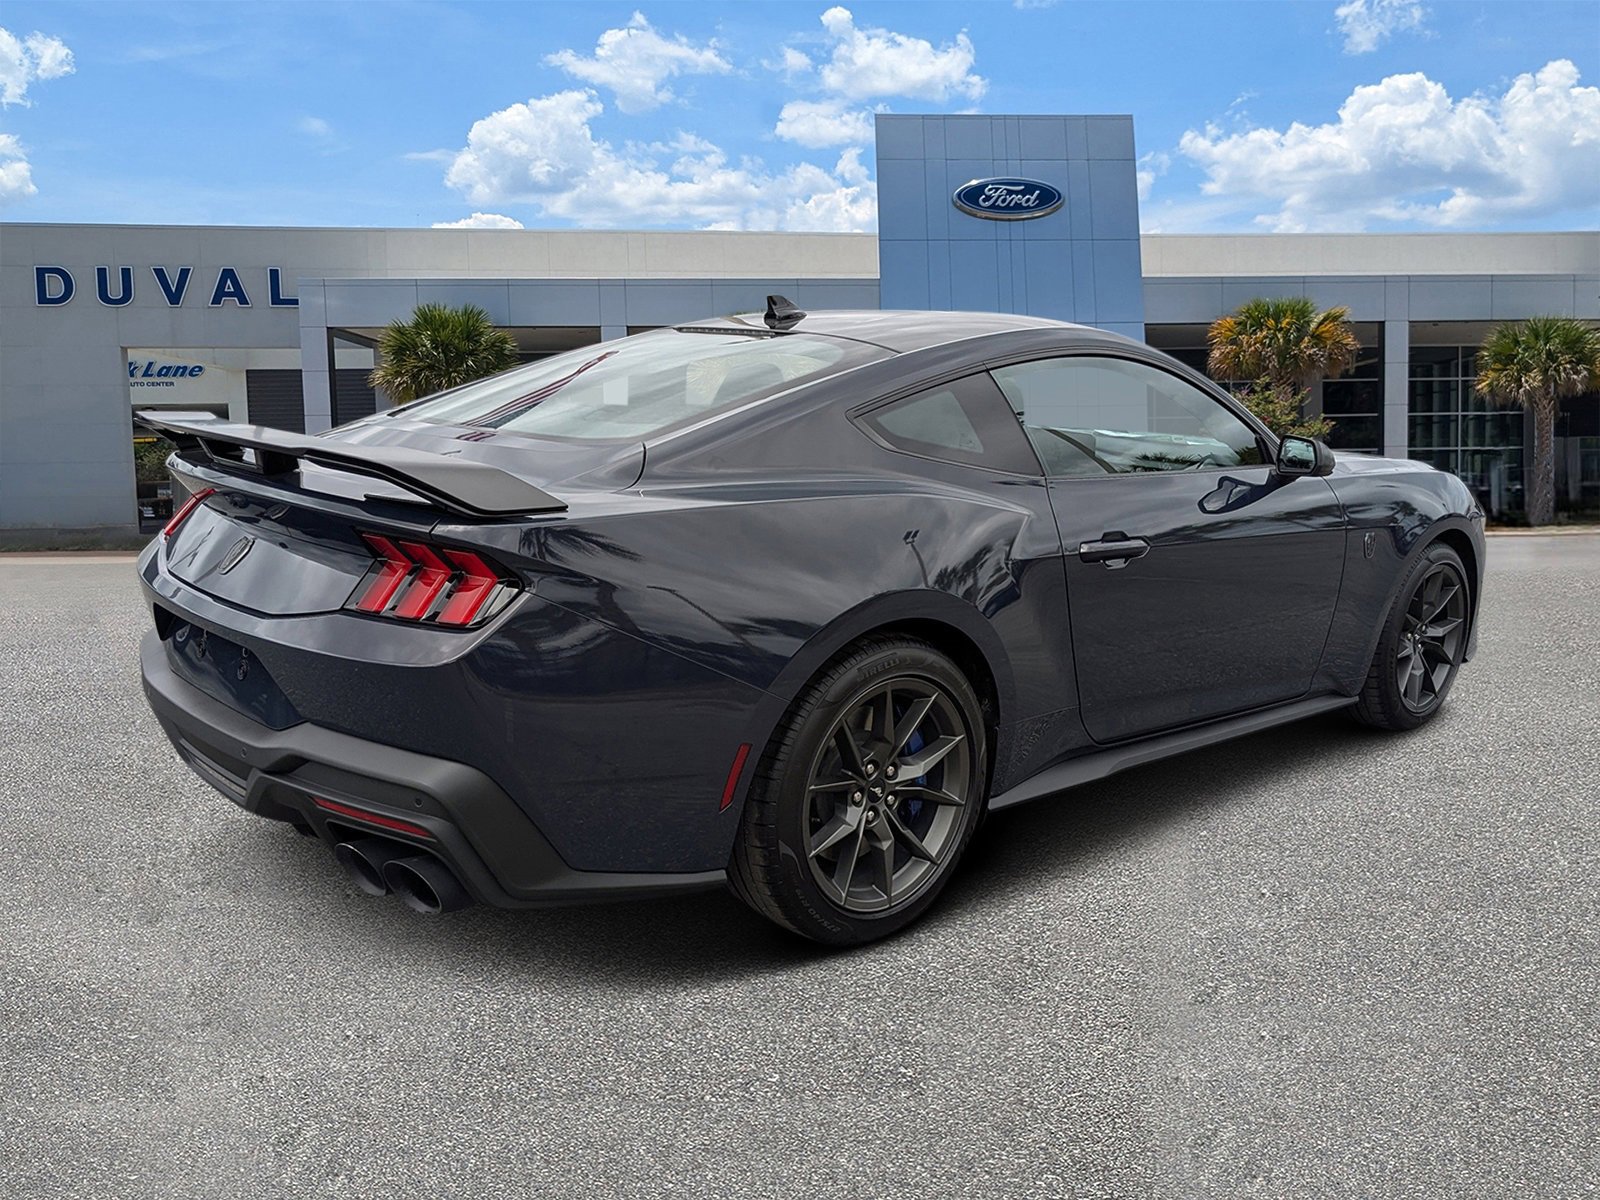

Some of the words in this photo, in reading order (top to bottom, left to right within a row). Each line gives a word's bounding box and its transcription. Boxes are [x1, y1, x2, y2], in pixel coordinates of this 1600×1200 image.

[979, 184, 1041, 207] Ford
[34, 265, 299, 307] DUVAL
[141, 361, 205, 378] Lane
